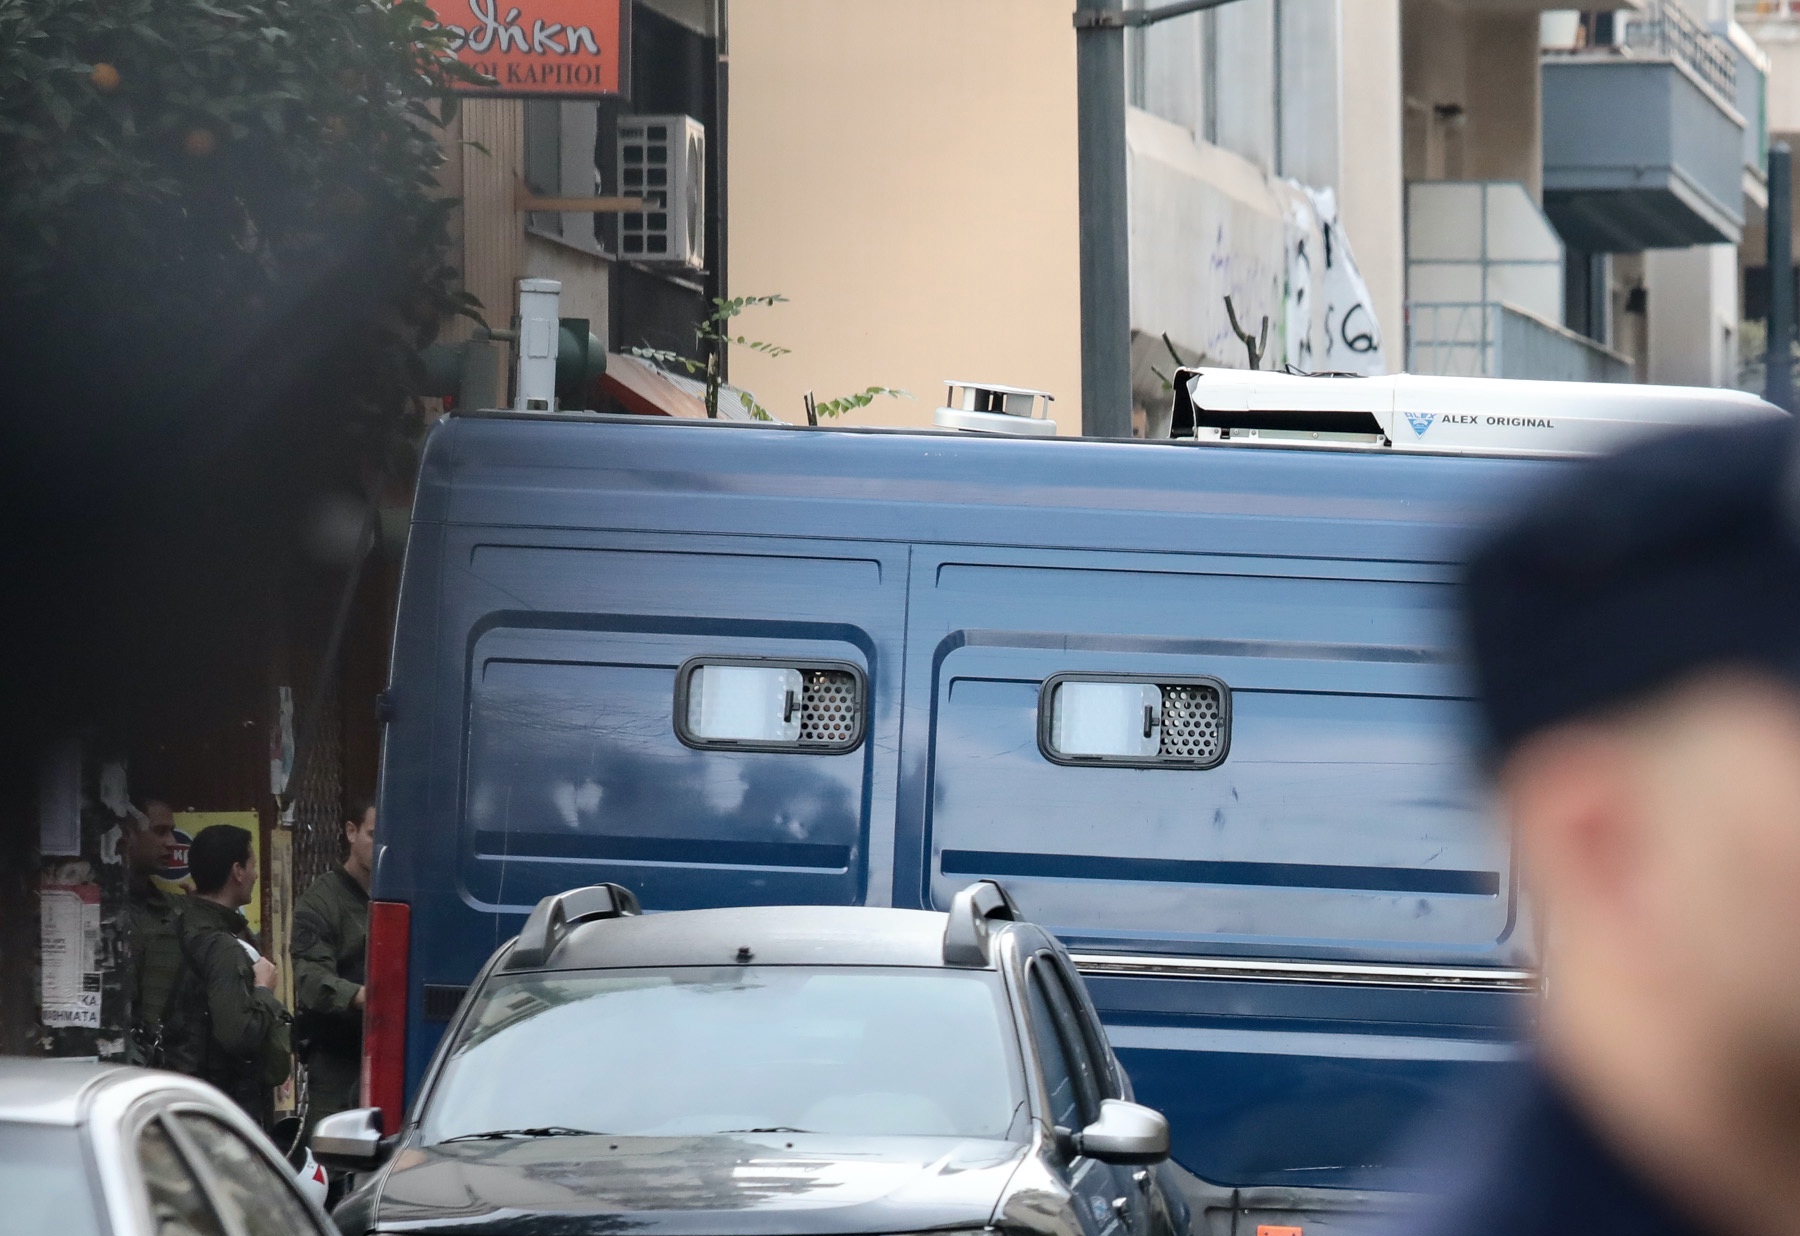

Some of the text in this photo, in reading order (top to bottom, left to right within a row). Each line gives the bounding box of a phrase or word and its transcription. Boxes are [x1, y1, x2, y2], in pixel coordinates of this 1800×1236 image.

[424, 0, 600, 54] οθήκη
[507, 62, 601, 86] ΚΑΡΠΟΙ
[1404, 411, 1437, 419] ALEX
[1441, 414, 1555, 428] ALEX ORIGINAL
